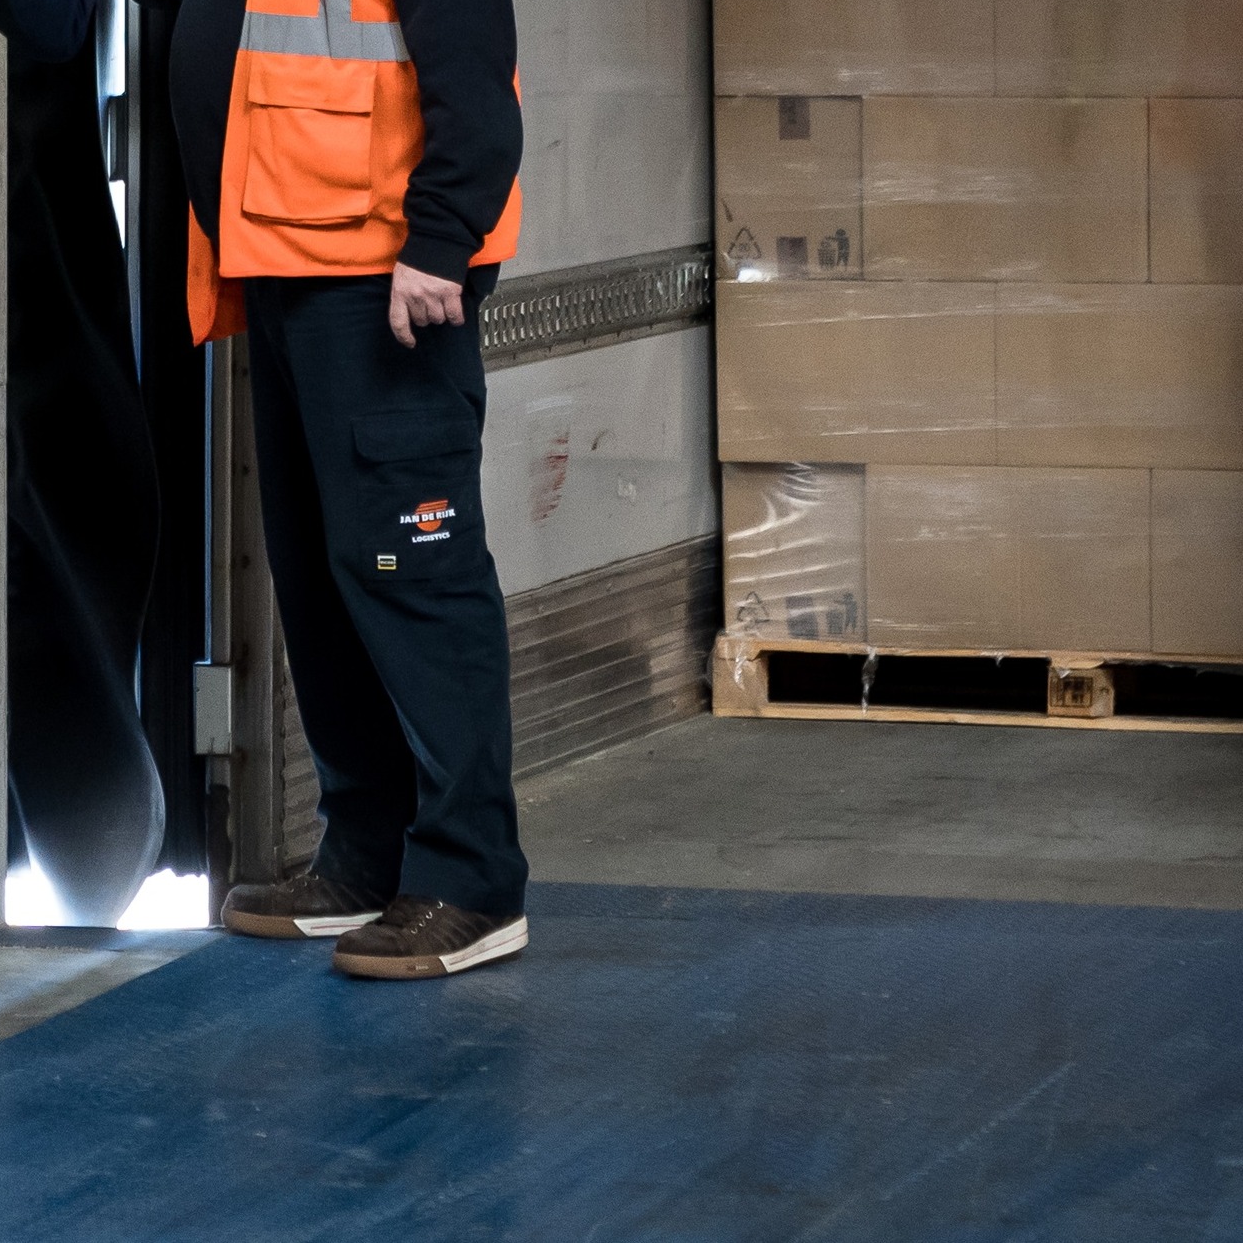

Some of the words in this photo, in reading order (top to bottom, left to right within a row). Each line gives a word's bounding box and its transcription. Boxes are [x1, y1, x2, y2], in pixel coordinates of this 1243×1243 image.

[400, 515, 419, 524] JAN
[421, 513, 435, 522] DE
[436, 509, 455, 519] RIJK
[412, 532, 450, 543] LOGISTICS
